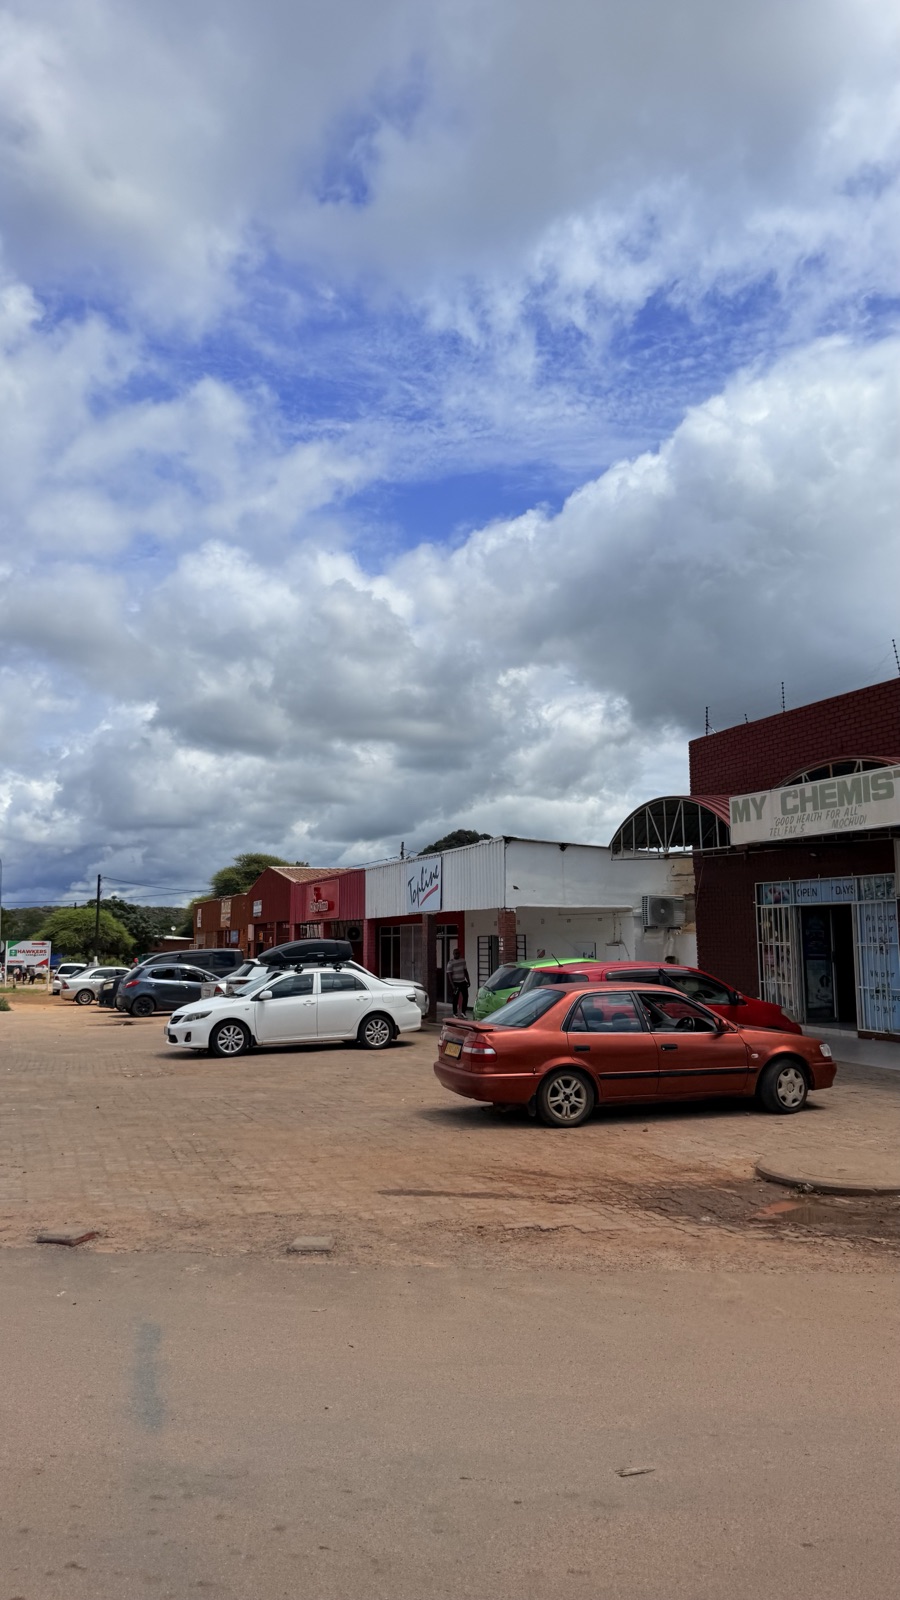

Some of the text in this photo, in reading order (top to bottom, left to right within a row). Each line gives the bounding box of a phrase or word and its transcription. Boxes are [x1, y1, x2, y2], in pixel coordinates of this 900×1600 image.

[731, 769, 900, 824] MY CHEMIS
[796, 811, 822, 824] HEALTH
[825, 808, 841, 820] FOR
[831, 814, 867, 829] MOCHUDI
[407, 864, 440, 909] Topline
[796, 887, 818, 897] OPEN
[835, 885, 854, 895] DAYS
